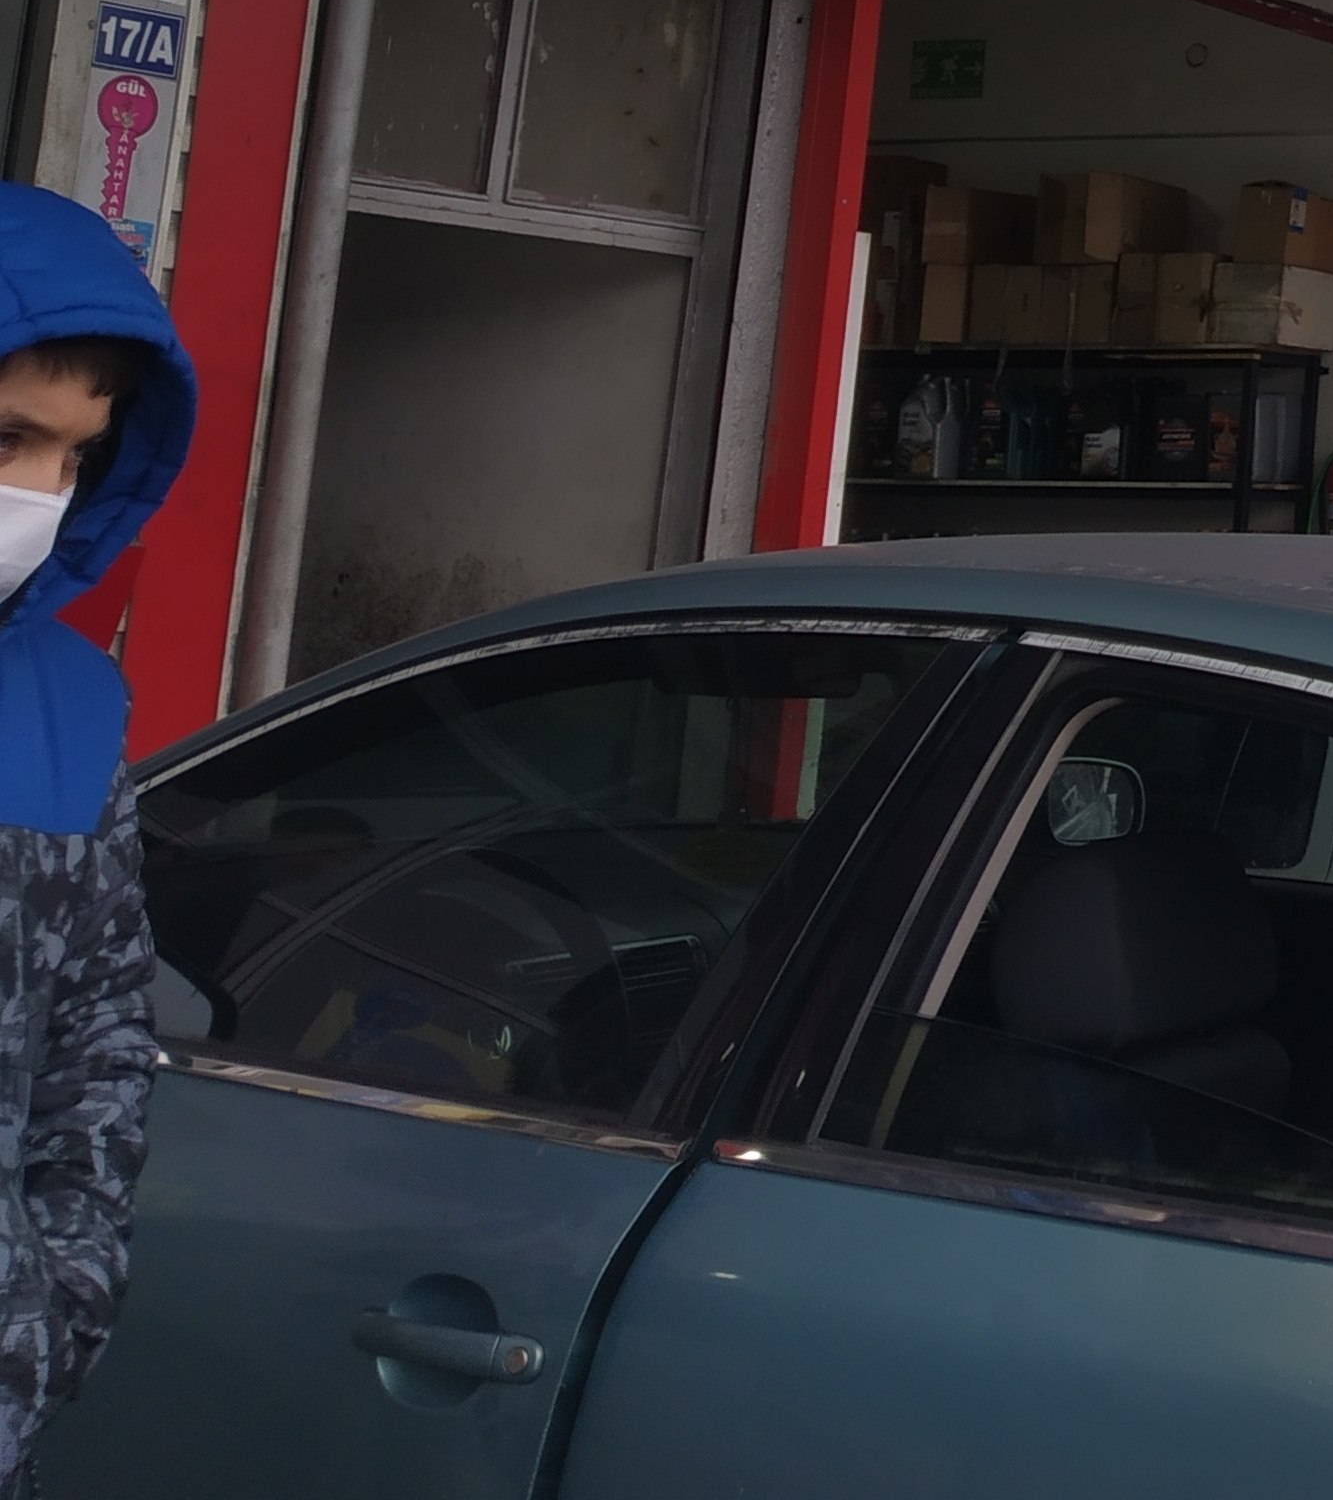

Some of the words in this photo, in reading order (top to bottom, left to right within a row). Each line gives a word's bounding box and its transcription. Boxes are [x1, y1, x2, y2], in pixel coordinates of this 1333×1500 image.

[101, 16, 173, 67] 17/A
[116, 79, 147, 99] GÜL
[107, 134, 128, 218] ANAHTAR
